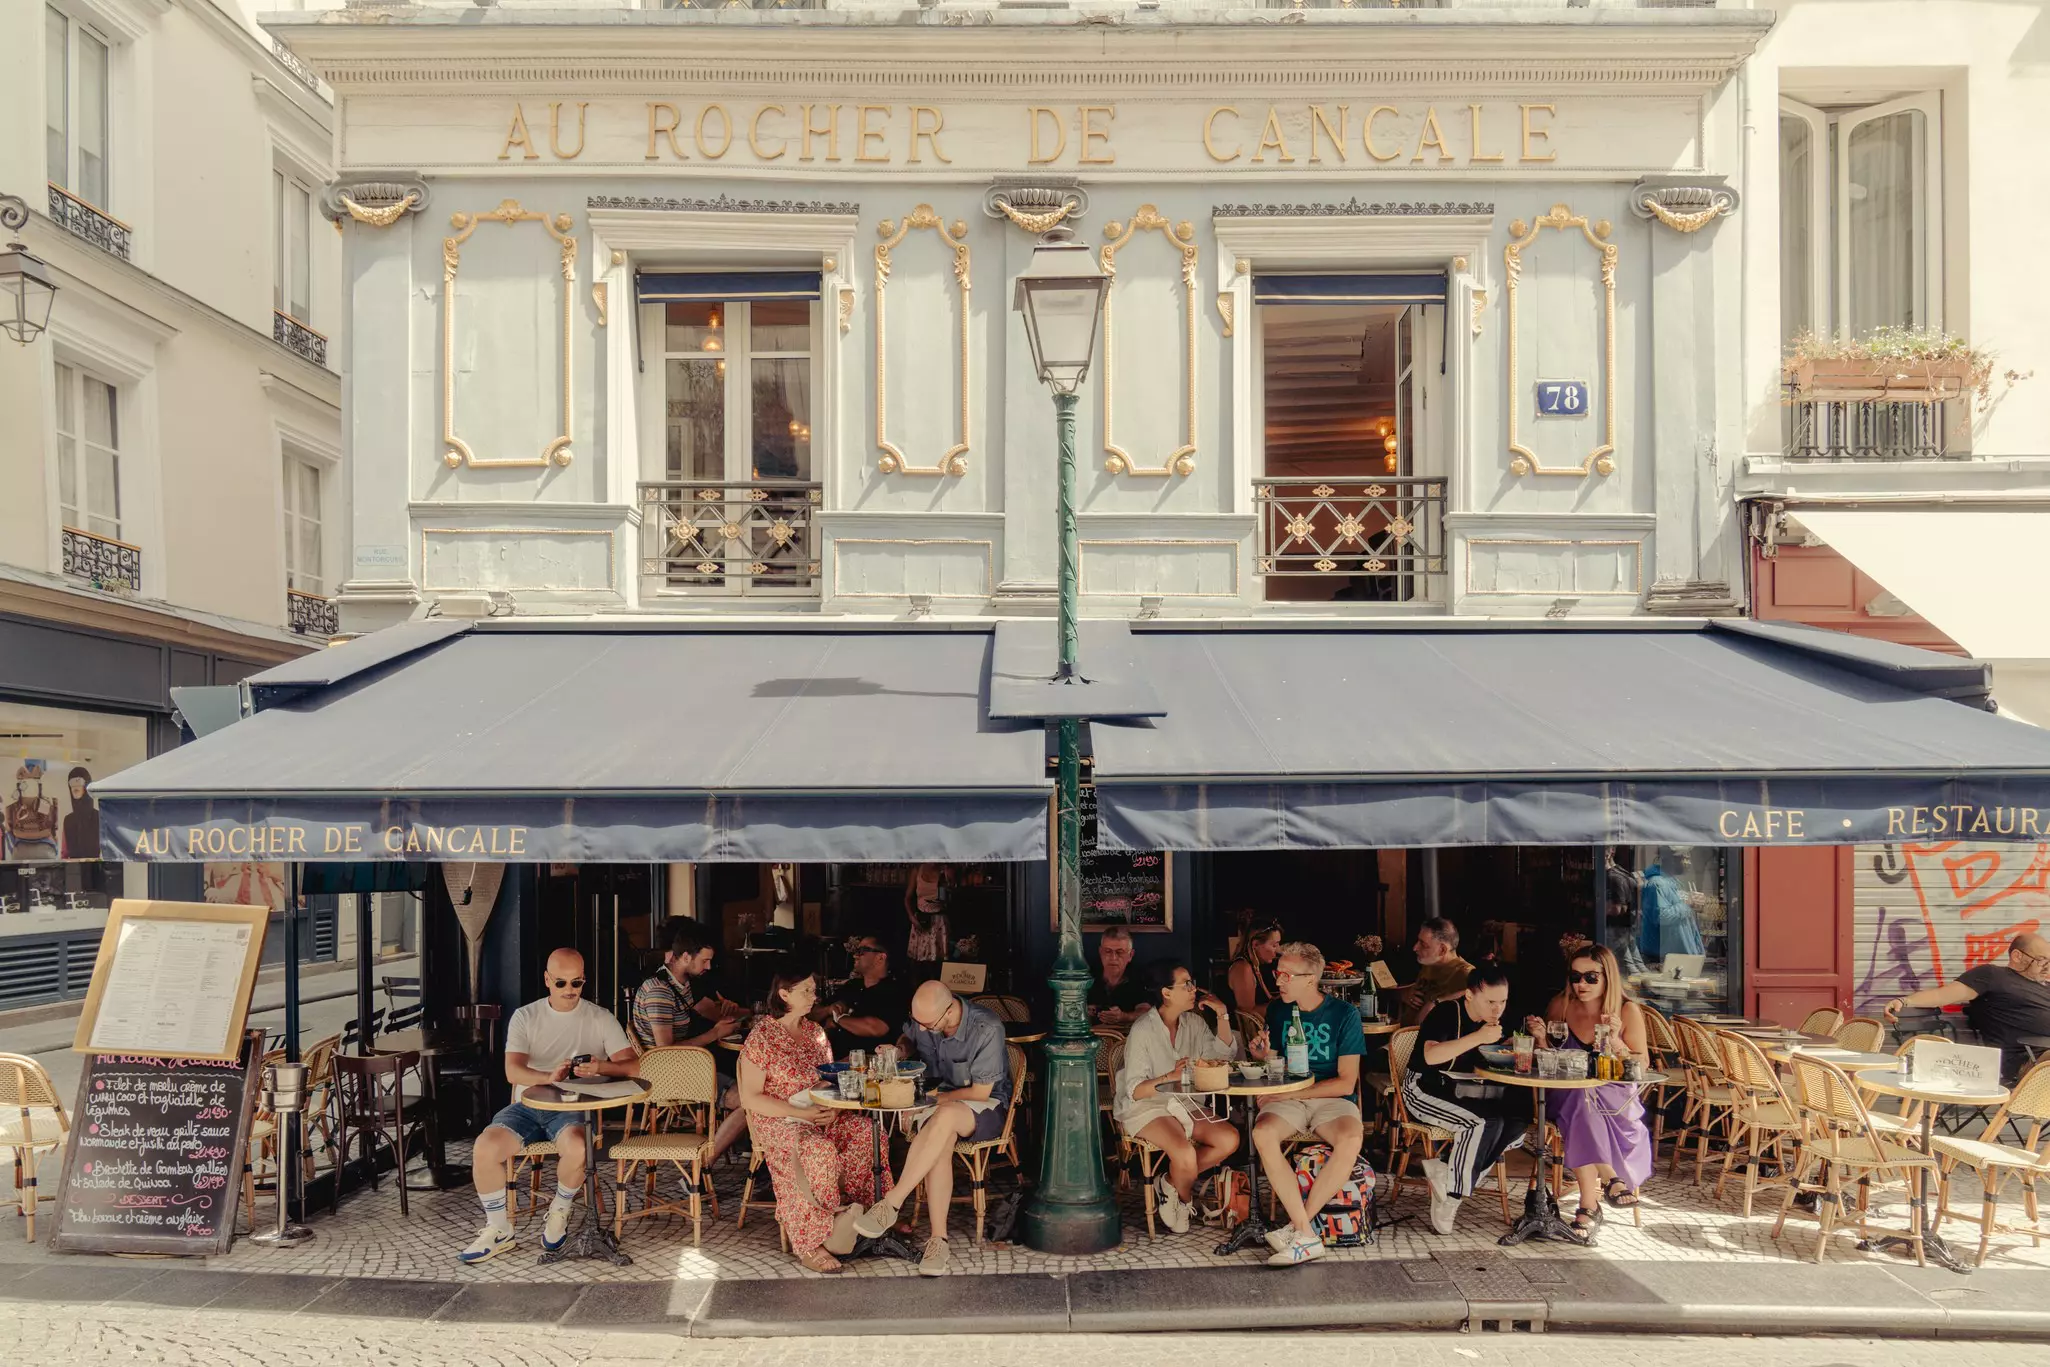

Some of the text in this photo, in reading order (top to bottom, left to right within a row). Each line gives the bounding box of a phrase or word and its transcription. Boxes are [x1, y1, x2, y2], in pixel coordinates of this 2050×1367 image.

[497, 102, 1557, 165] AU ROCHER DE CANCALE
[1546, 386, 1580, 410] 78
[1719, 810, 1806, 839] CAFE
[134, 826, 528, 855] AU ROCHER DE CANCALE
[134, 1078, 147, 1091] de
[210, 1080, 226, 1093] de
[116, 1093, 136, 1101] coco
[137, 1092, 150, 1104] et
[209, 1095, 225, 1107] de
[132, 1122, 145, 1136] de
[200, 1126, 230, 1137] sauce
[140, 1160, 153, 1175] de
[118, 1176, 133, 1189] de
[119, 1194, 167, 1205] DESSERT
